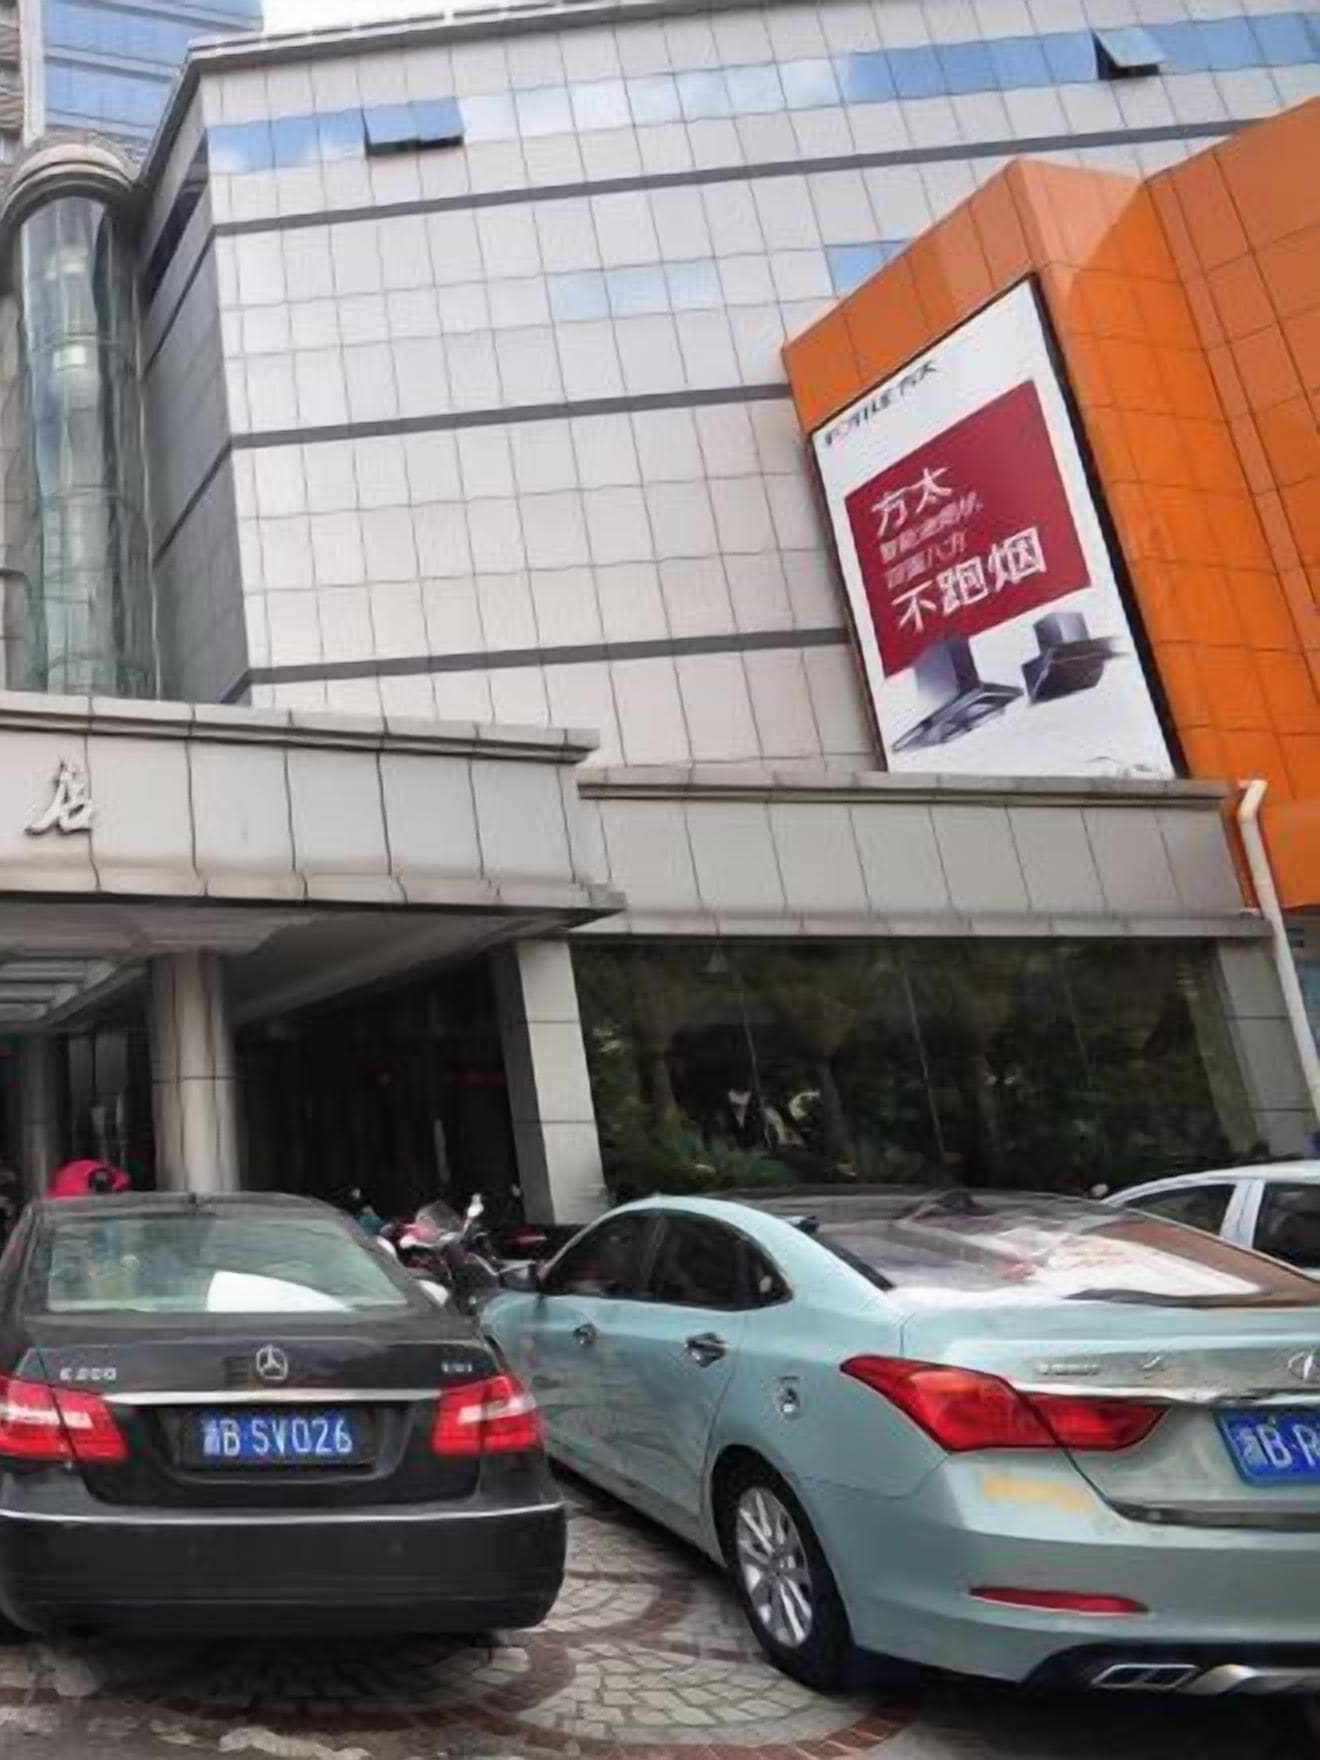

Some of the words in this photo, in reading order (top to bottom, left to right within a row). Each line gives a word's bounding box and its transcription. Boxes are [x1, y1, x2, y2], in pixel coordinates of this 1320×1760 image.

[872, 466, 952, 537] 方太
[891, 526, 1047, 632] 不跑烟
